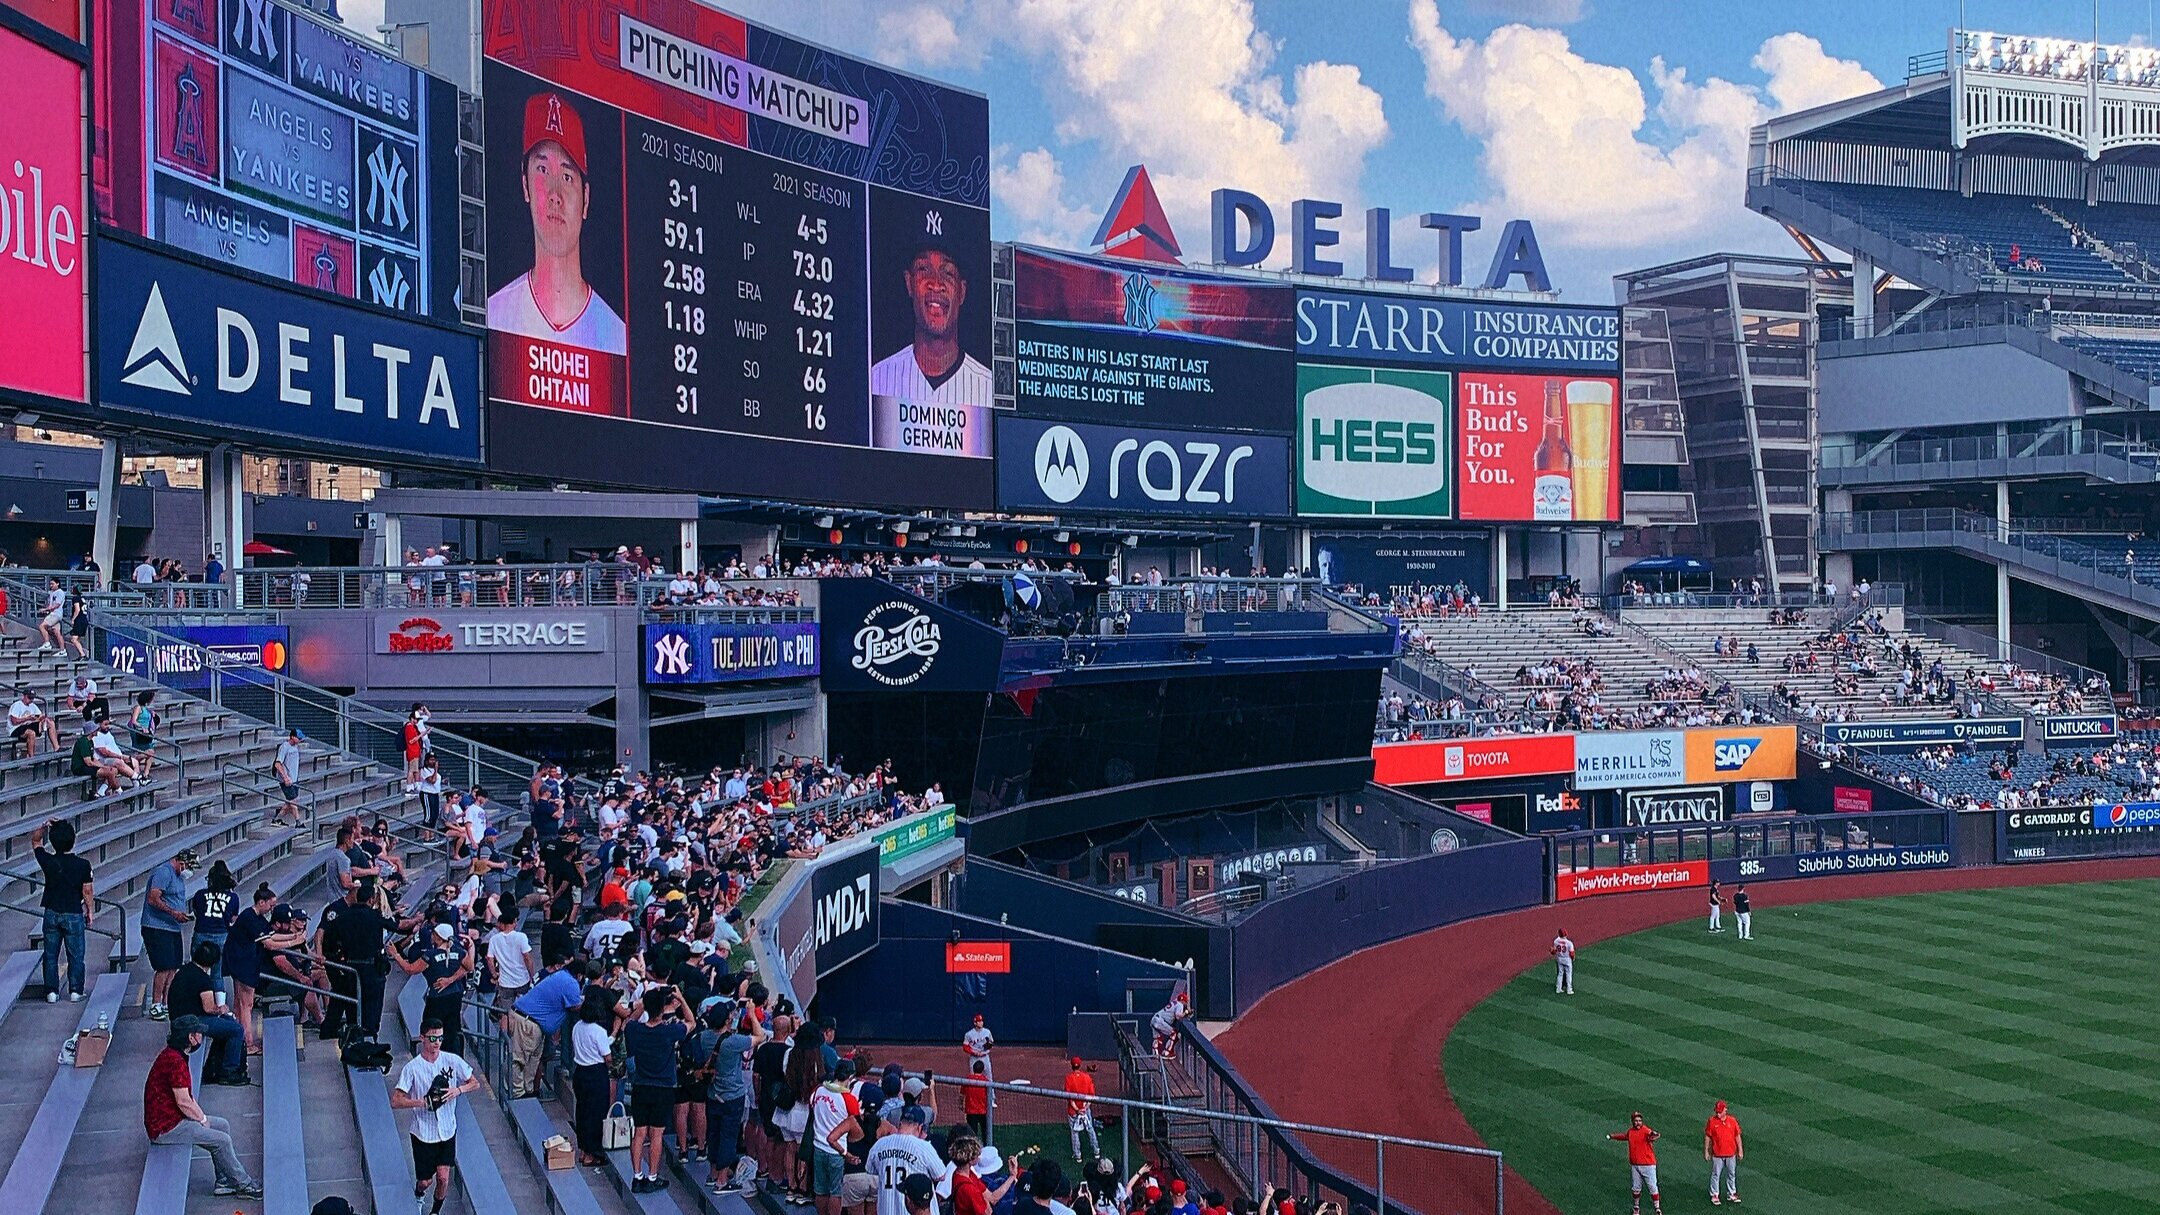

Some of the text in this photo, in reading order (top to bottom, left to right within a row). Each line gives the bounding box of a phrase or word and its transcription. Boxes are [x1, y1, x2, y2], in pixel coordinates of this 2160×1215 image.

[344, 51, 362, 73] VS
[295, 52, 410, 121] YANKEES
[630, 27, 739, 99] PITCHING
[749, 75, 861, 136] MATCHUP
[250, 98, 332, 151] ANGELS
[283, 143, 301, 162] VS
[642, 132, 723, 175] 2021 SEASON
[232, 145, 350, 209] YANKEES
[773, 173, 851, 208] 2021 SEASON
[669, 179, 697, 213] 3-1
[184, 194, 271, 245] ANGELS
[737, 202, 761, 224] W-L
[664, 218, 703, 254] 59.1
[798, 214, 828, 244] 4-5
[1211, 188, 1552, 292] DELTA
[218, 238, 237, 258] VS
[743, 242, 755, 261] IP
[663, 260, 705, 295] 2.58
[793, 250, 833, 283] 73.0
[738, 281, 762, 301] ERA
[794, 289, 834, 320] 4.32
[665, 301, 705, 335] 1.18
[734, 319, 767, 341] WHIP
[1296, 297, 1454, 355] STARR
[1473, 310, 1618, 338] INSURANCE
[796, 327, 832, 357] 1.21
[1473, 335, 1618, 362] COMPANIES
[217, 307, 460, 430] DELTA
[528, 345, 589, 378] SHOHEI
[674, 344, 698, 374] 82
[743, 360, 760, 379] SO
[1019, 340, 1209, 374] BATTERS IN HIS LAST START LAST
[803, 367, 826, 393] 66
[1019, 360, 1214, 393] WEDNESDAY AGAINST THE GIANTS.
[528, 375, 589, 407] OHTANI
[676, 385, 698, 415] 31
[1019, 380, 1145, 405] THE ANGELS LOST THE
[1465, 382, 1517, 406] This
[743, 399, 760, 418] BB
[805, 403, 826, 431] 16
[899, 404, 966, 428] DOMINGO
[903, 423, 963, 450] GERMÁN
[1312, 418, 1436, 465] HESS
[1466, 435, 1504, 458] For
[1110, 437, 1254, 504] razr
[1465, 461, 1515, 484] You.
[1406, 562, 1436, 570] 1930-2010
[1389, 585, 1414, 597] THE
[864, 601, 920, 625] PEPSI LOUNGE
[459, 622, 586, 646] TERRACE
[712, 637, 737, 671] TUE,
[738, 637, 762, 667] JULY
[763, 636, 778, 666] 20
[796, 635, 814, 666] PHI
[867, 656, 934, 685] ESTABLISHED 1898
[1851, 729, 1895, 739] FANDUEL
[1966, 725, 2009, 736] FANDUEL
[1467, 751, 1509, 767] TOYOTA
[1578, 757, 1646, 772] MERRILL
[1715, 744, 1751, 766] SAP
[1648, 771, 1681, 779] COMPANY
[1536, 793, 1581, 812] FedEx
[1631, 797, 1718, 825] VIKING
[2024, 813, 2075, 825] GATORADE
[880, 835, 897, 856] et365
[2014, 848, 2045, 858] YANKEES
[1799, 850, 1949, 873] StubHub StubHub StubHub
[815, 885, 855, 951] AMD
[965, 953, 1003, 962] State Farm
[878, 1148, 917, 1165] RODRIGUEZ
